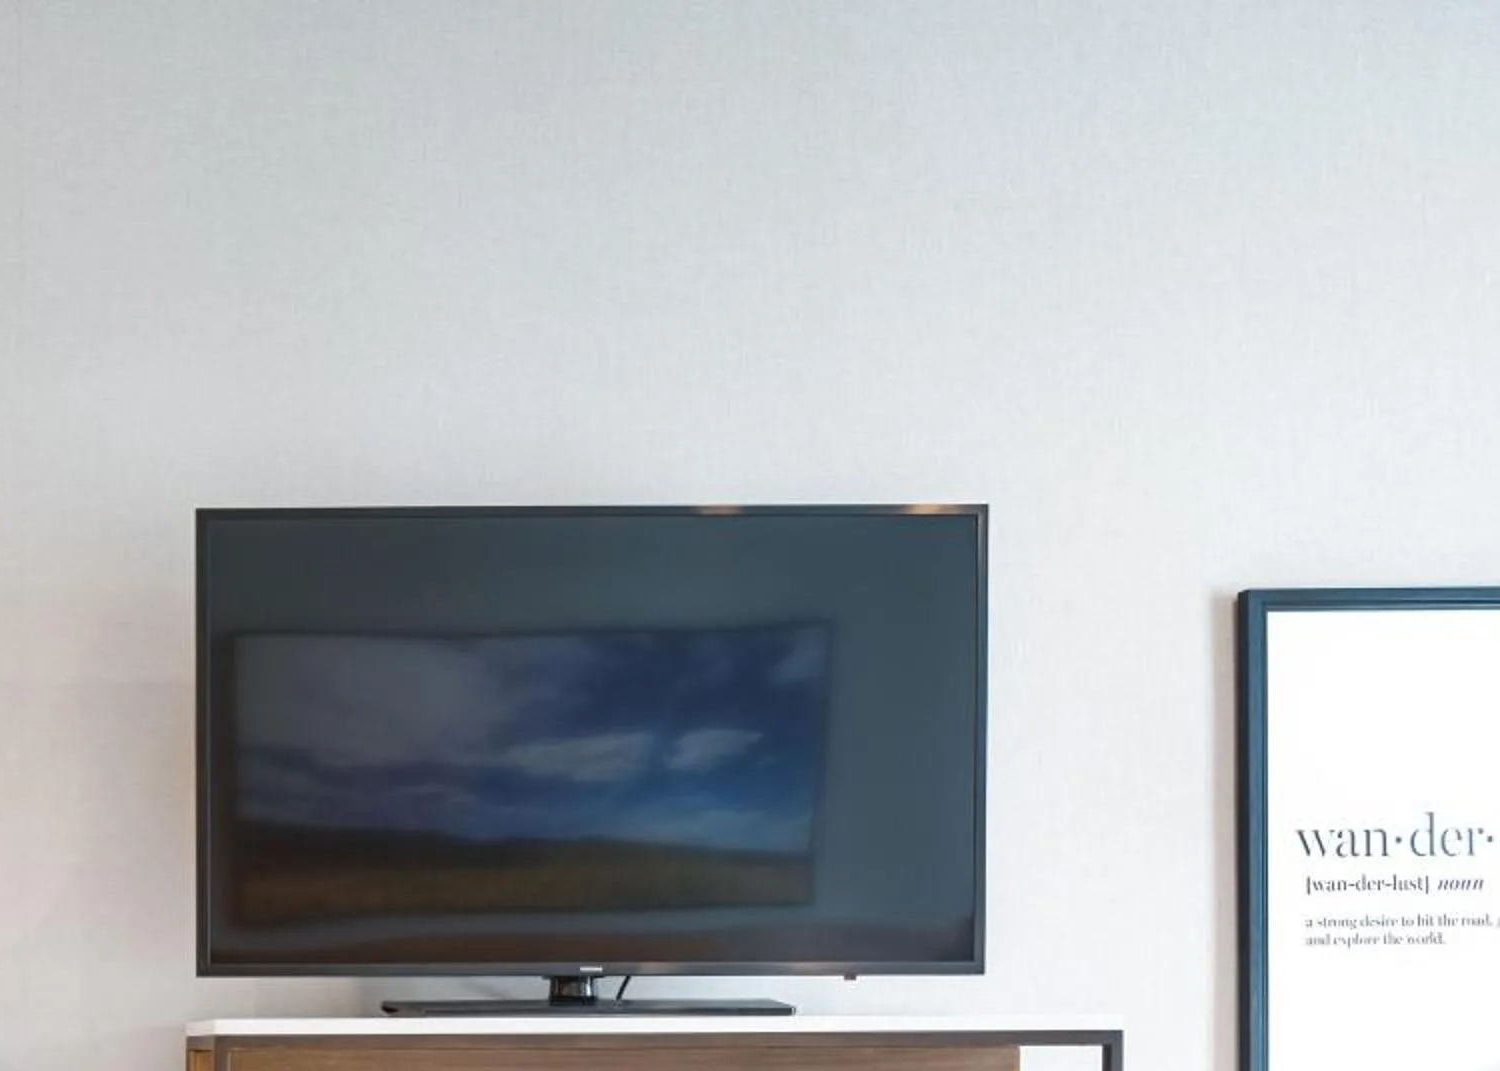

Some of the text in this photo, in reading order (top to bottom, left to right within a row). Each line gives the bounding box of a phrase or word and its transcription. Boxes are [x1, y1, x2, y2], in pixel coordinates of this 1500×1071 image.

[1306, 873, 1485, 895] [wan-der-lust] noun
[1304, 917, 1313, 928] a
[1316, 916, 1357, 930] strong
[1359, 913, 1399, 928] desire
[1401, 915, 1415, 928] to
[1417, 913, 1435, 928] hit
[1437, 913, 1459, 928] the
[1304, 933, 1331, 946] and
[1333, 932, 1381, 950] explore
[1383, 931, 1404, 945] the
